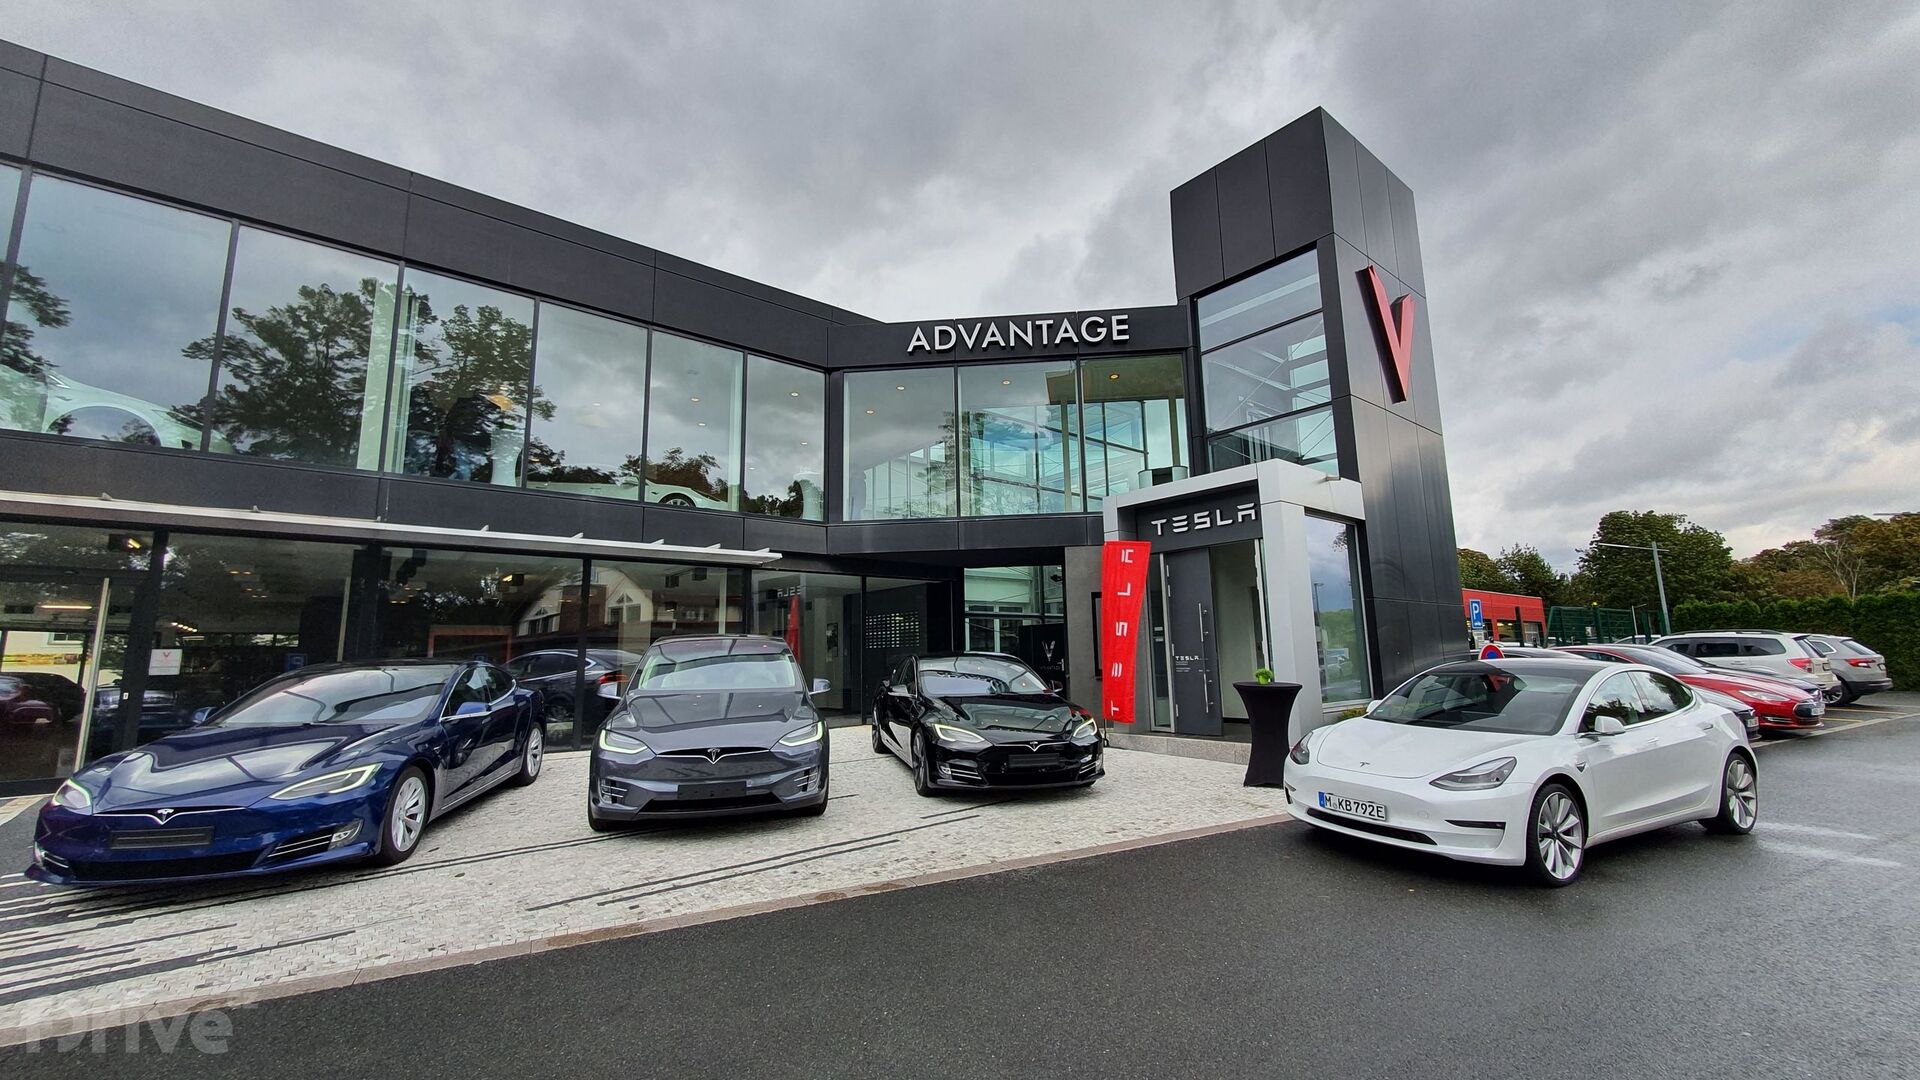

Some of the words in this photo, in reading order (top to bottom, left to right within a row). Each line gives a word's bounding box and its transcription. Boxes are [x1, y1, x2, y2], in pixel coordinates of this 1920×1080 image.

[907, 314, 1130, 353] ADVANTAGE
[1151, 502, 1257, 536] TESLA
[1472, 602, 1480, 620] P
[1110, 548, 1135, 717] TESLA
[1324, 795, 1332, 807] M
